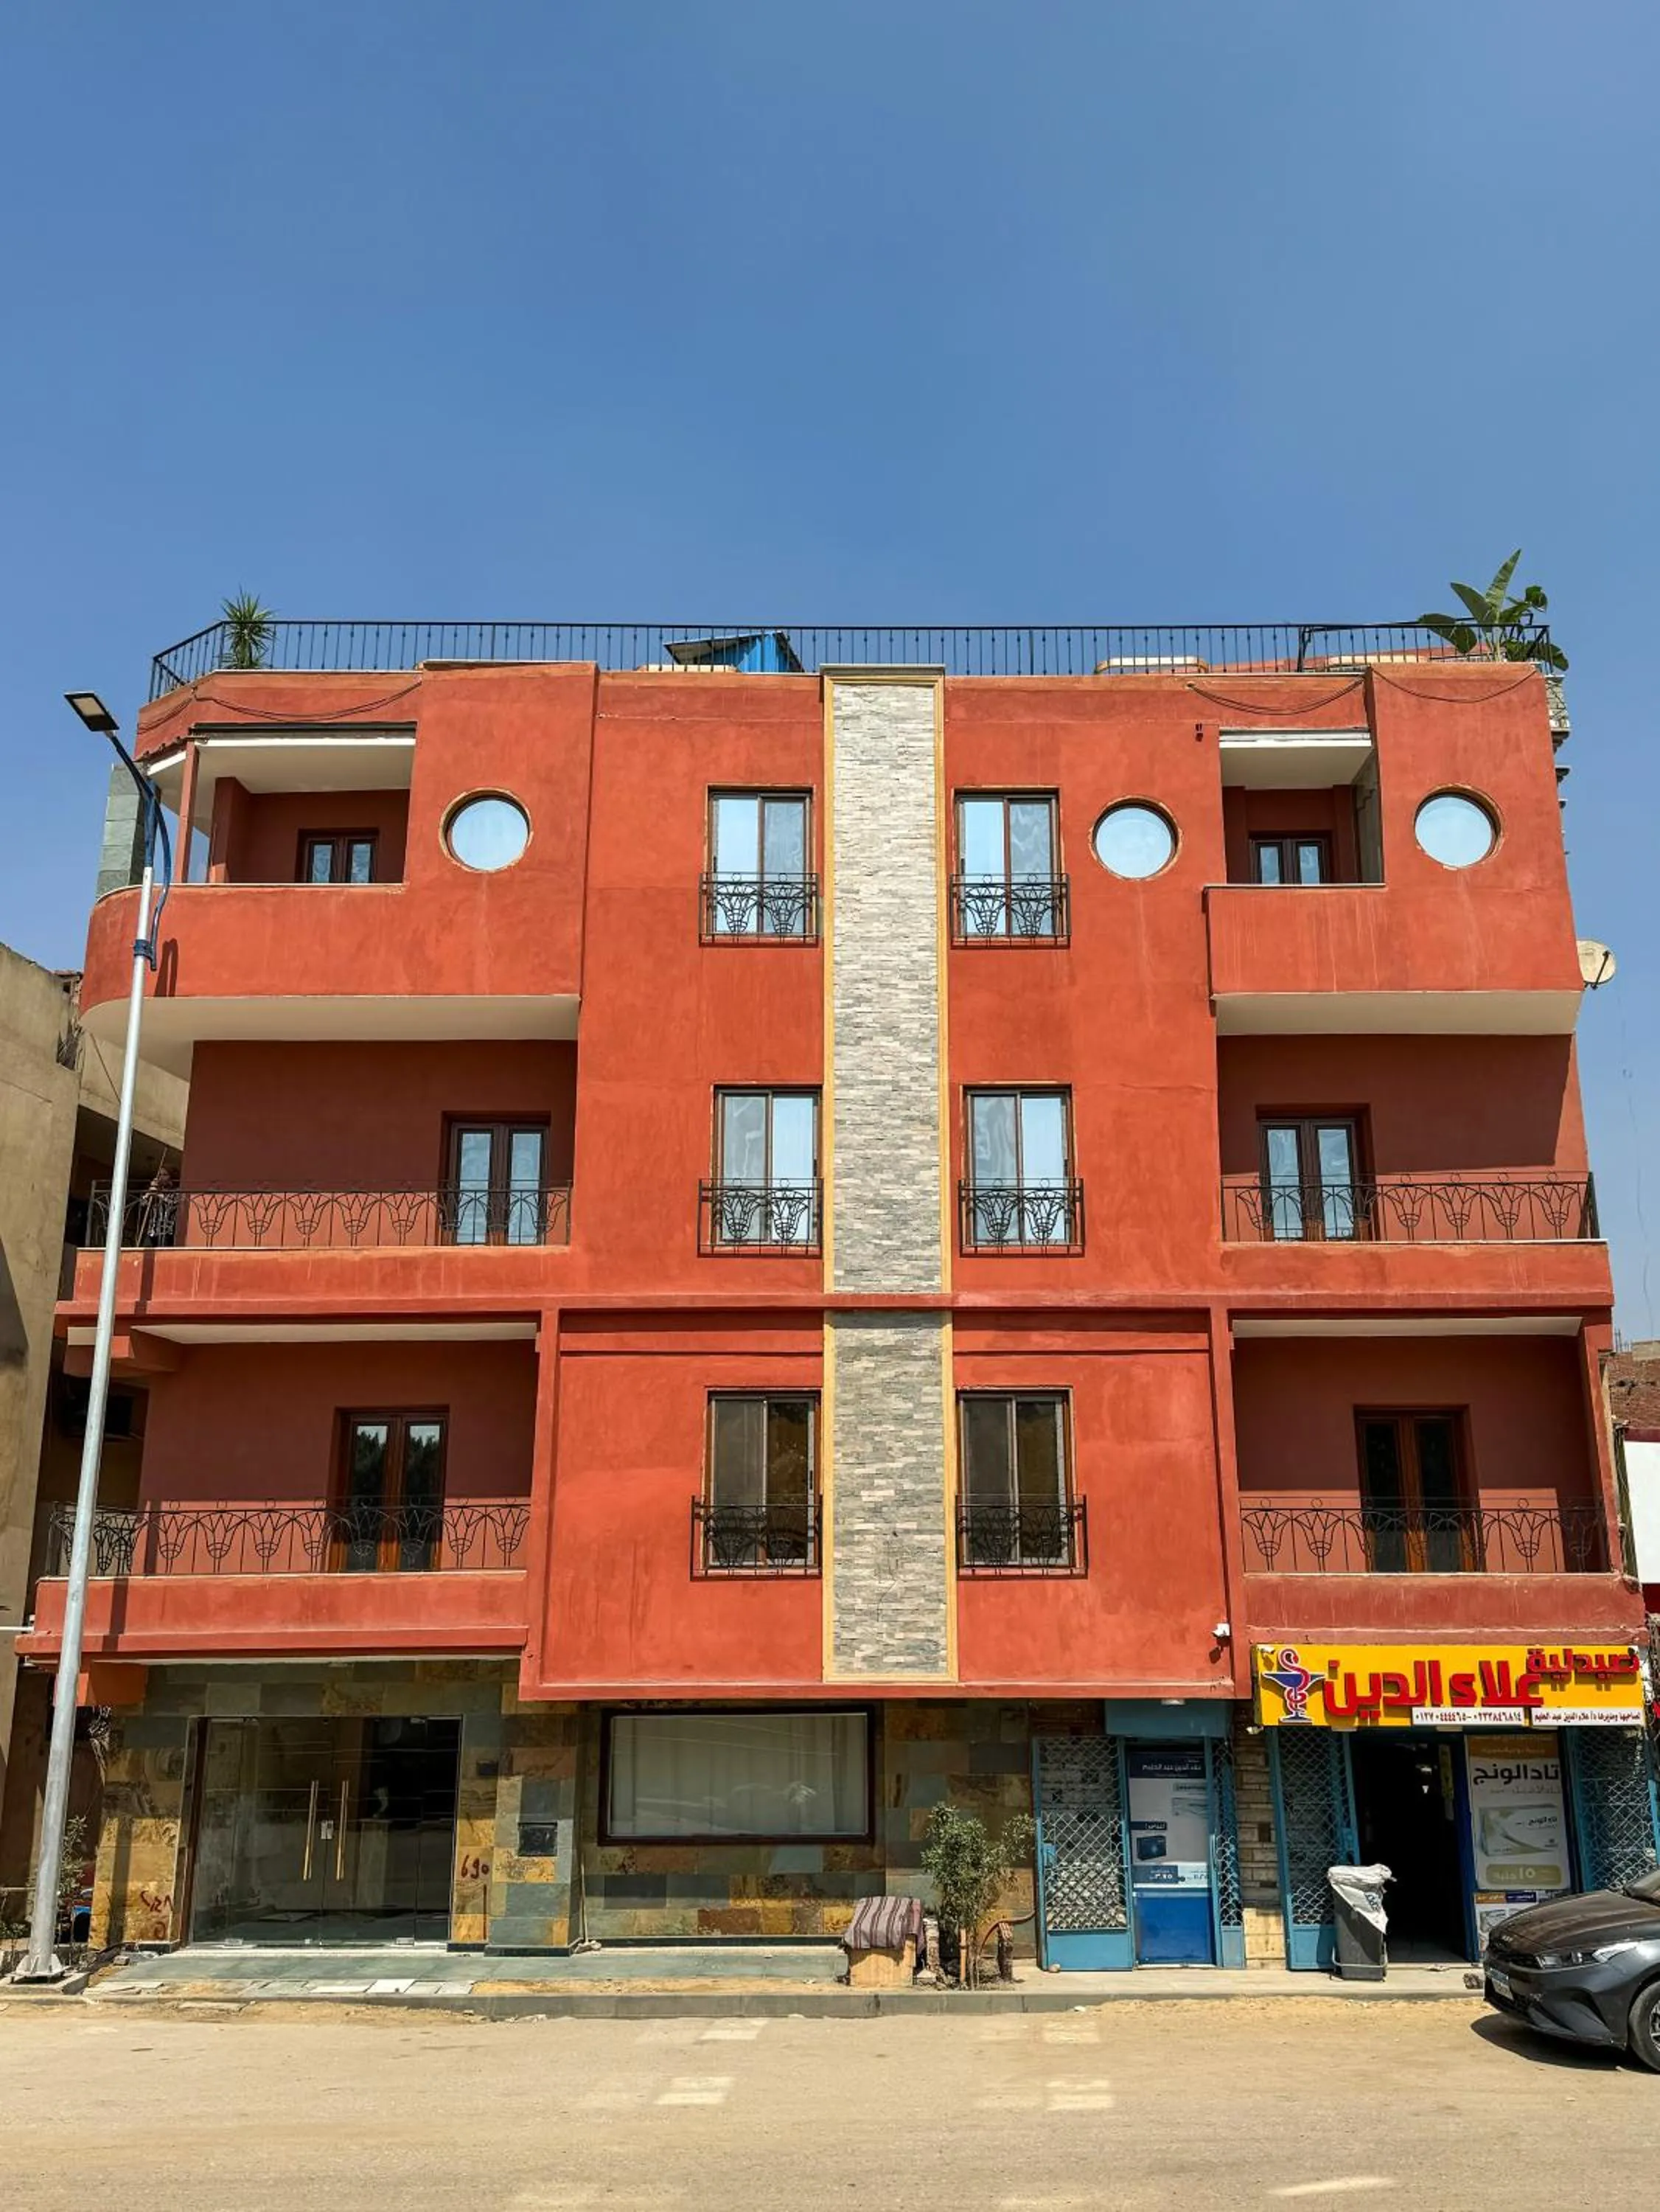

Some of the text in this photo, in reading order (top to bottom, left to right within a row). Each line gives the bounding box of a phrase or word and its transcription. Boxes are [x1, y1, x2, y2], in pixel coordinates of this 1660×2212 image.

[1527, 1648, 1640, 1680] صيدلية
[1322, 1660, 1544, 1720] علاء الدين
[1473, 1763, 1559, 1785] تادالونج
